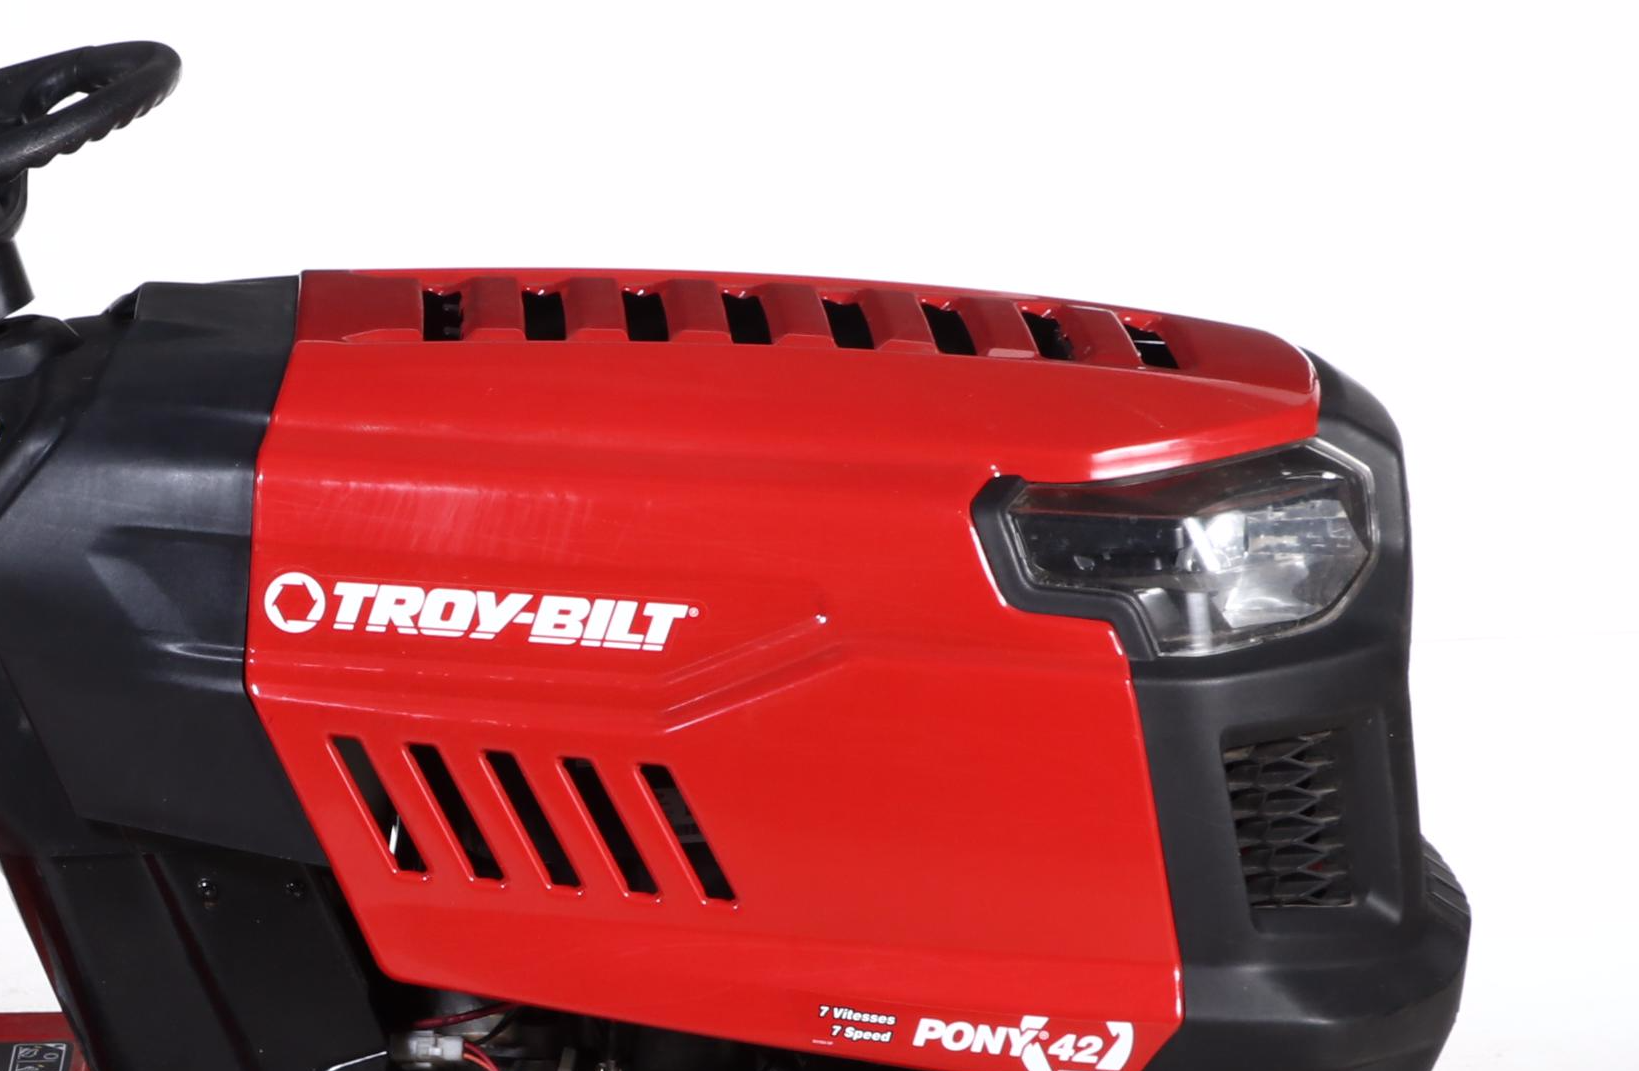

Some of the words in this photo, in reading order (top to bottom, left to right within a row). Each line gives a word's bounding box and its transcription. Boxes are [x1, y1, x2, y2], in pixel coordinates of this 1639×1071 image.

[333, 580, 689, 652] TROY-BILT
[819, 1005, 830, 1018] 7
[833, 1007, 896, 1025] Vitesses
[831, 1025, 842, 1036] 7
[844, 1026, 892, 1042] Speed
[913, 1016, 1039, 1057] PONY
[1048, 1034, 1104, 1064] 42
